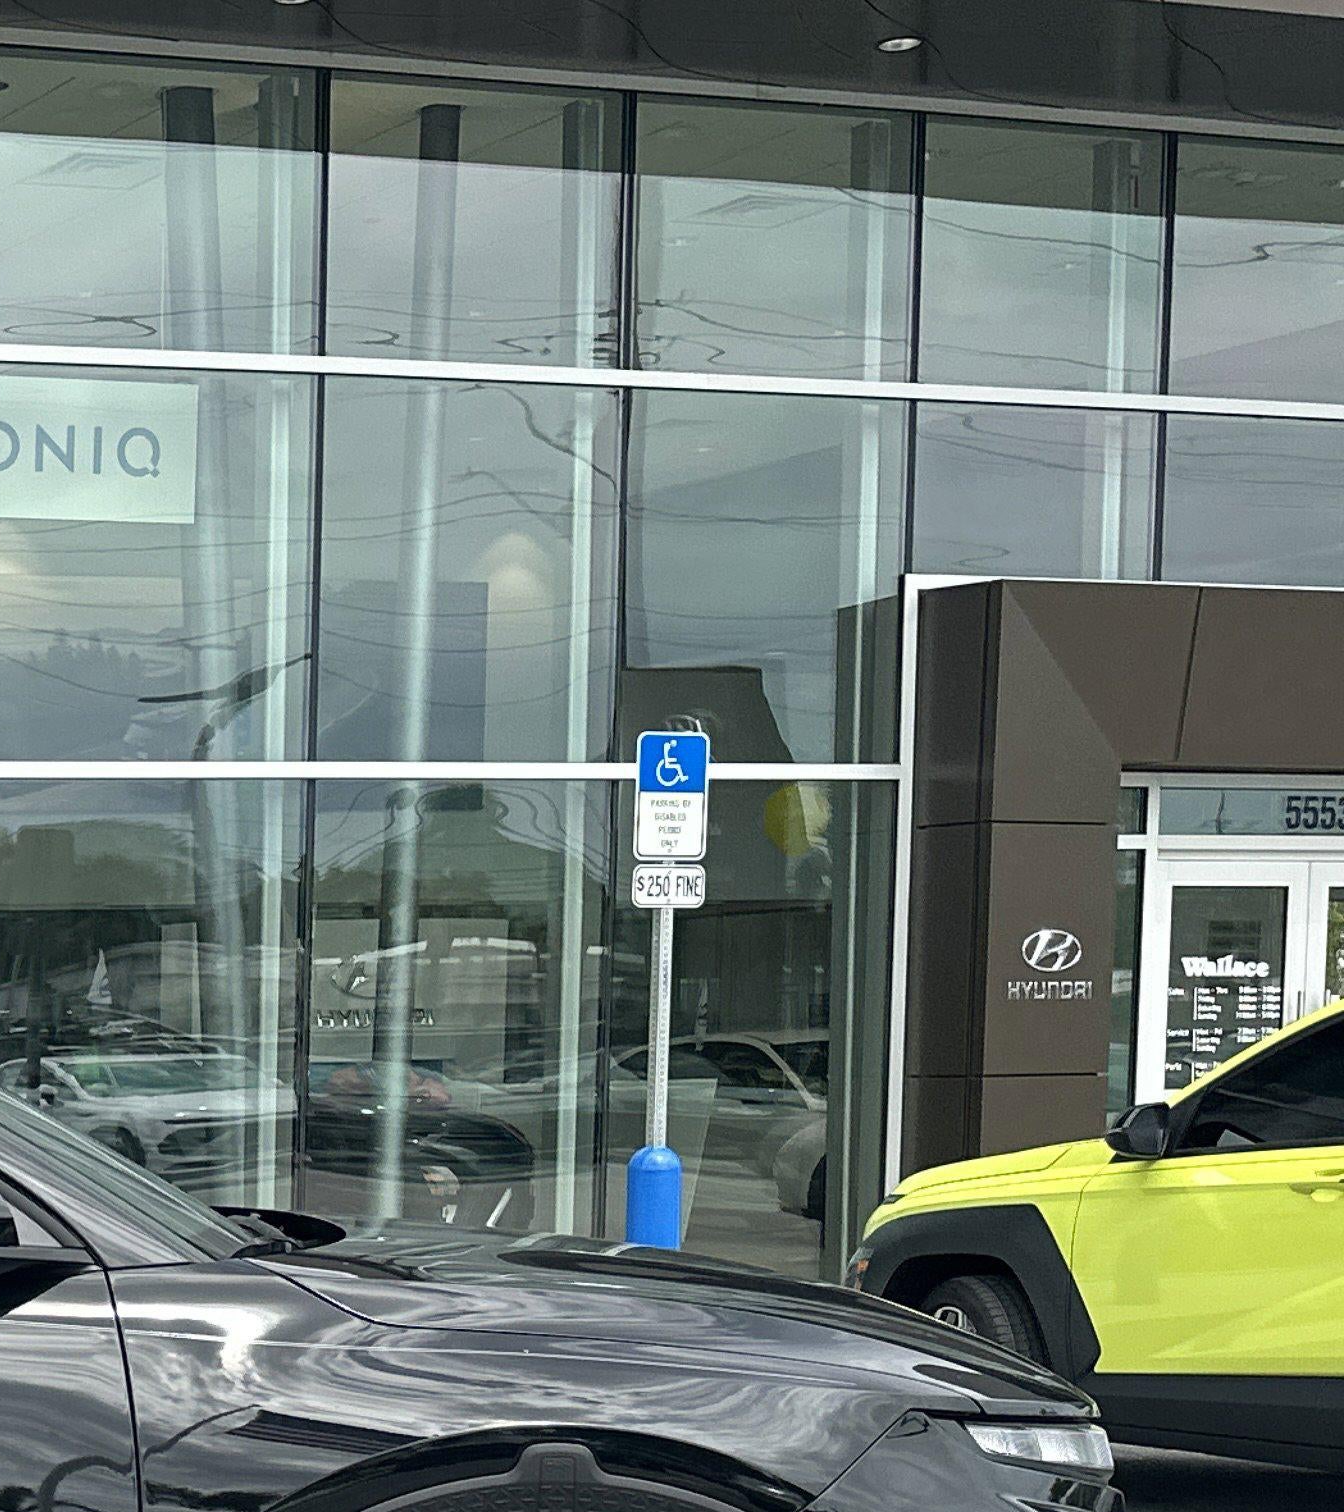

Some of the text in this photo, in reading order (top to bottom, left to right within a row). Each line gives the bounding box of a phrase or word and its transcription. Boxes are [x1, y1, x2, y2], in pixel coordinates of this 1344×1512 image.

[676, 875, 702, 897] FINE
[1180, 954, 1270, 978] Wallace
[1007, 981, 1092, 1000] HYUNDAI
[316, 1009, 434, 1028] HYUAI
